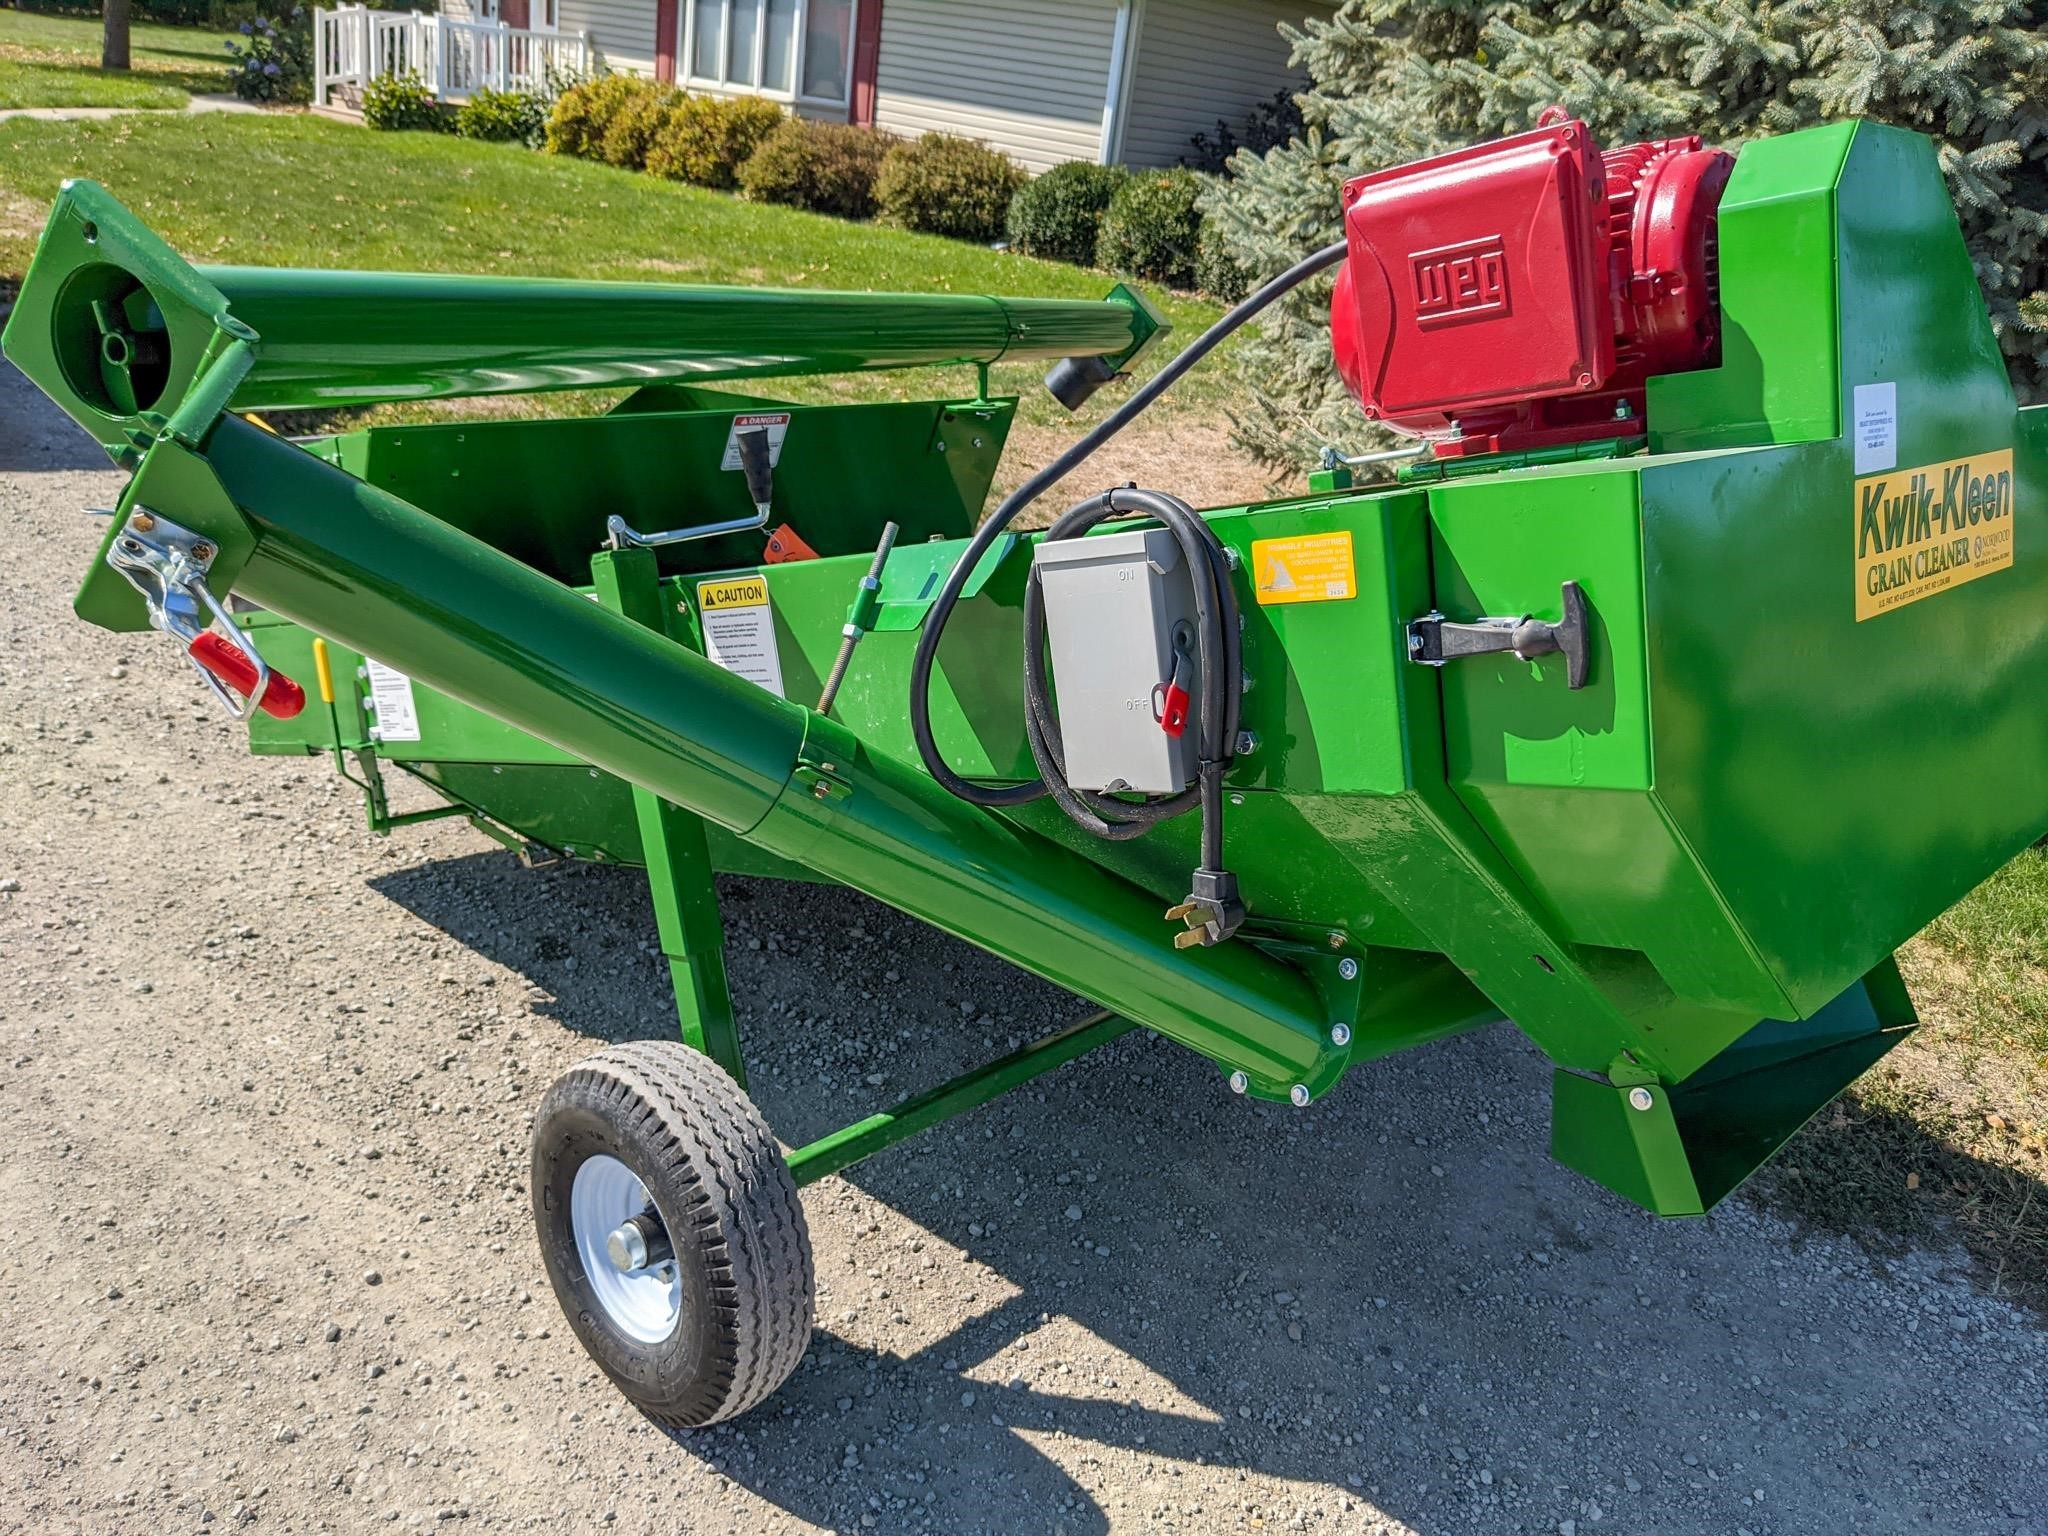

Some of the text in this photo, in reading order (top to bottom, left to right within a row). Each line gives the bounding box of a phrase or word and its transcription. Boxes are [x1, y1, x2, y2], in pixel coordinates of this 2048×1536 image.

[748, 416, 783, 425] DANGER
[1858, 464, 2011, 560] Kwik-Kleen
[1118, 568, 1134, 581] ON
[1867, 537, 1970, 597] GRAIN CLEANER
[716, 586, 762, 603] CAUTION
[1126, 699, 1148, 711] OFF
